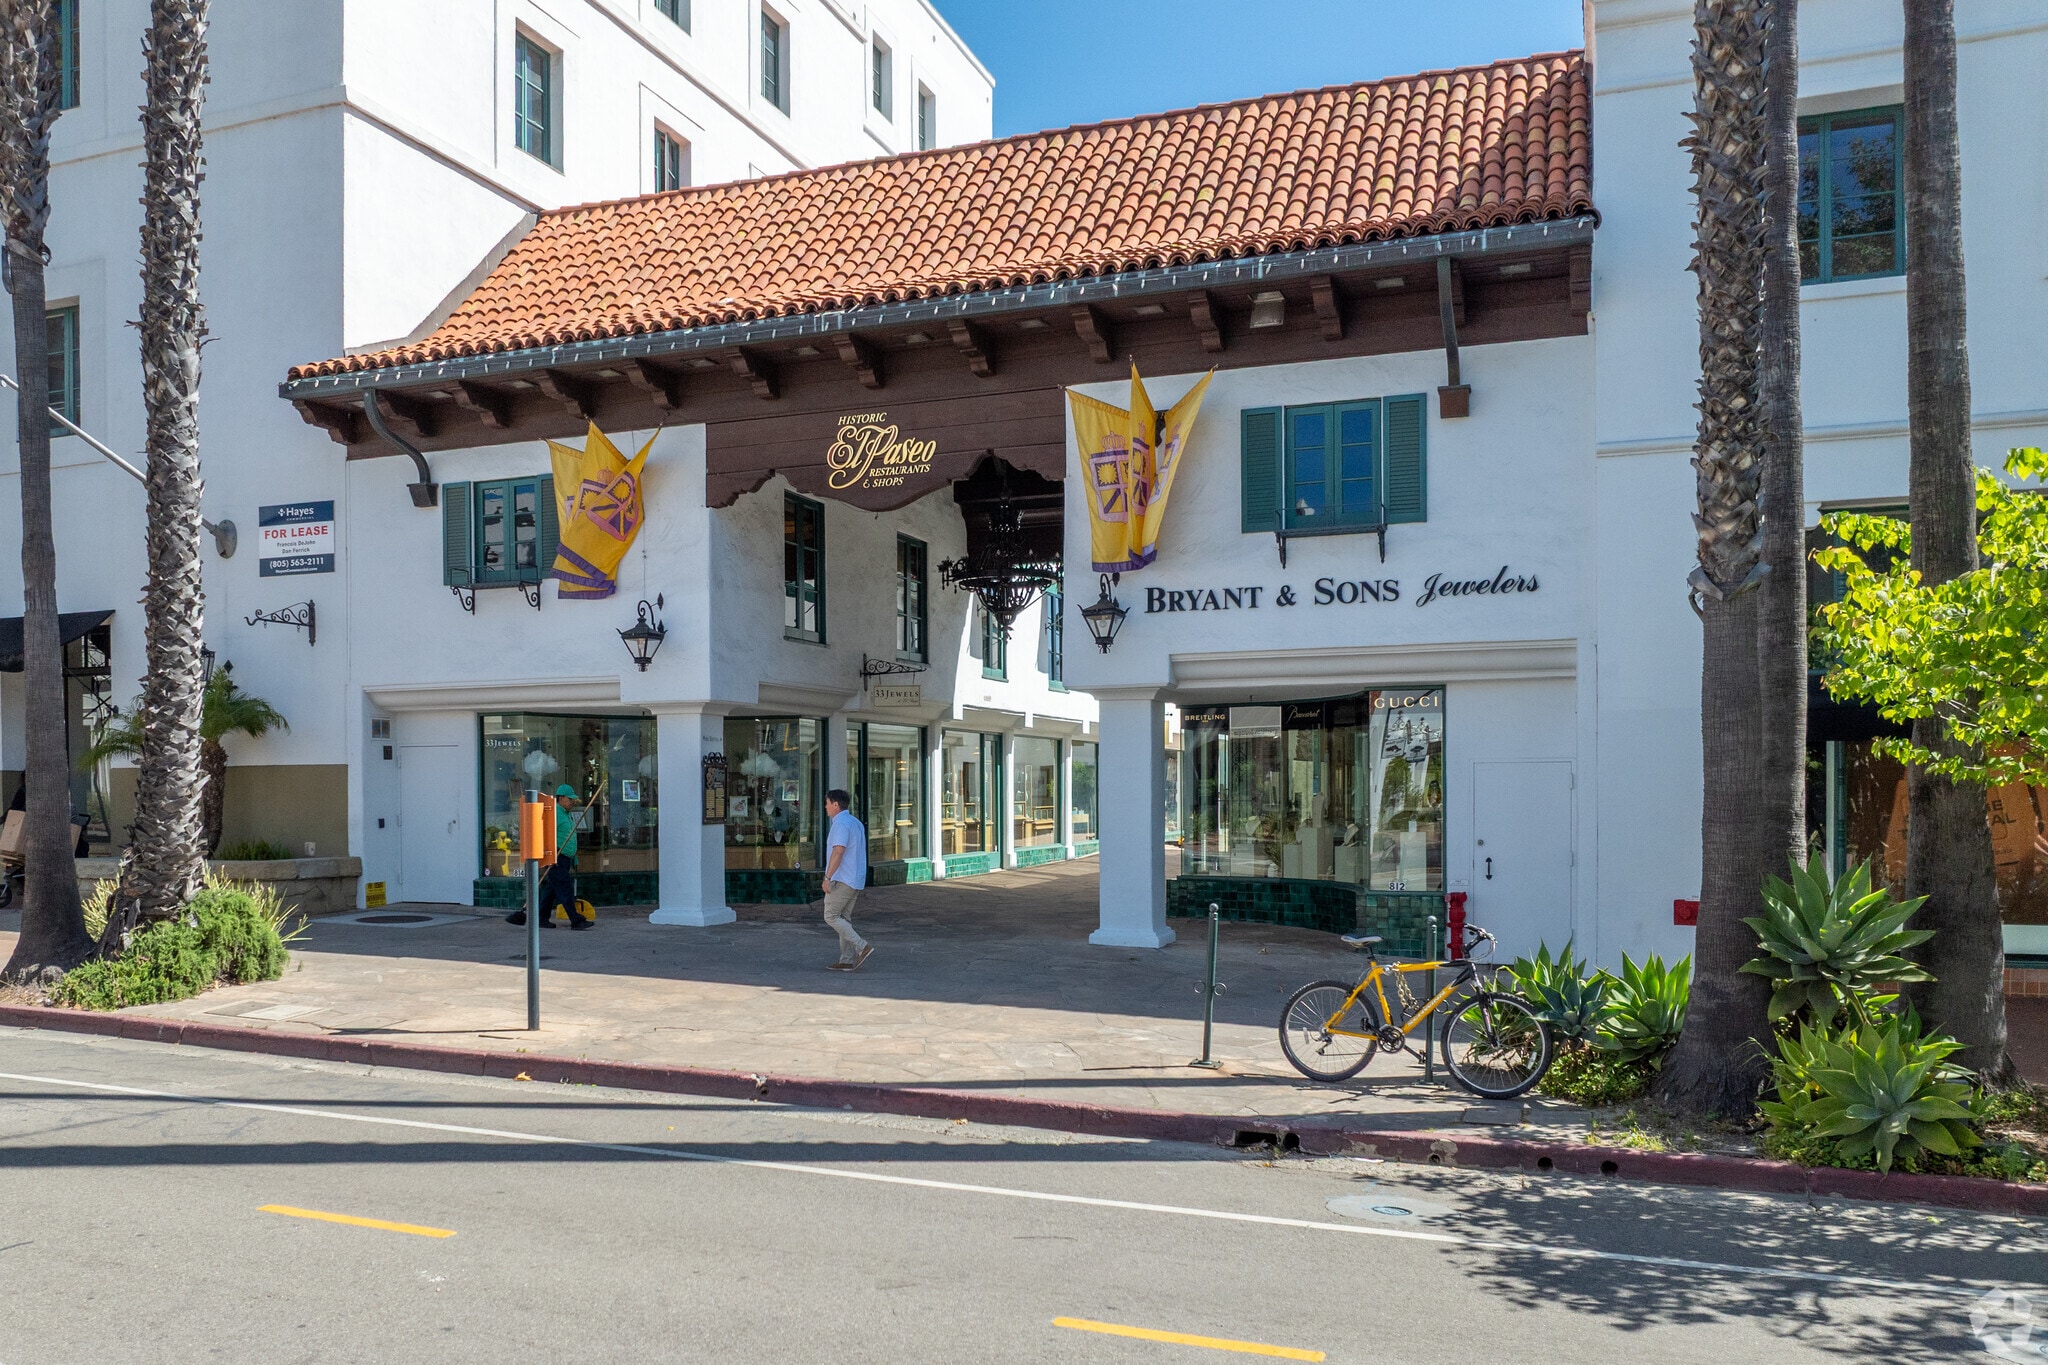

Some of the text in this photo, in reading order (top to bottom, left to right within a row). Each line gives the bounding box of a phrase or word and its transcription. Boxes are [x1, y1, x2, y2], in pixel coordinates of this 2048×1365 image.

[838, 412, 888, 425] HISTORIC
[827, 425, 937, 489] El Paseo
[869, 464, 932, 477] RESTAURANTS
[863, 477, 905, 489] & SHOPS
[286, 507, 315, 517] Hayes
[264, 525, 329, 540] FOR LEASE
[270, 557, 324, 569] (805) 563-2111
[1144, 565, 1540, 614] BRYANT & SONS Jewelers
[1374, 696, 1438, 709] GUCCI
[1389, 882, 1405, 891] 812
